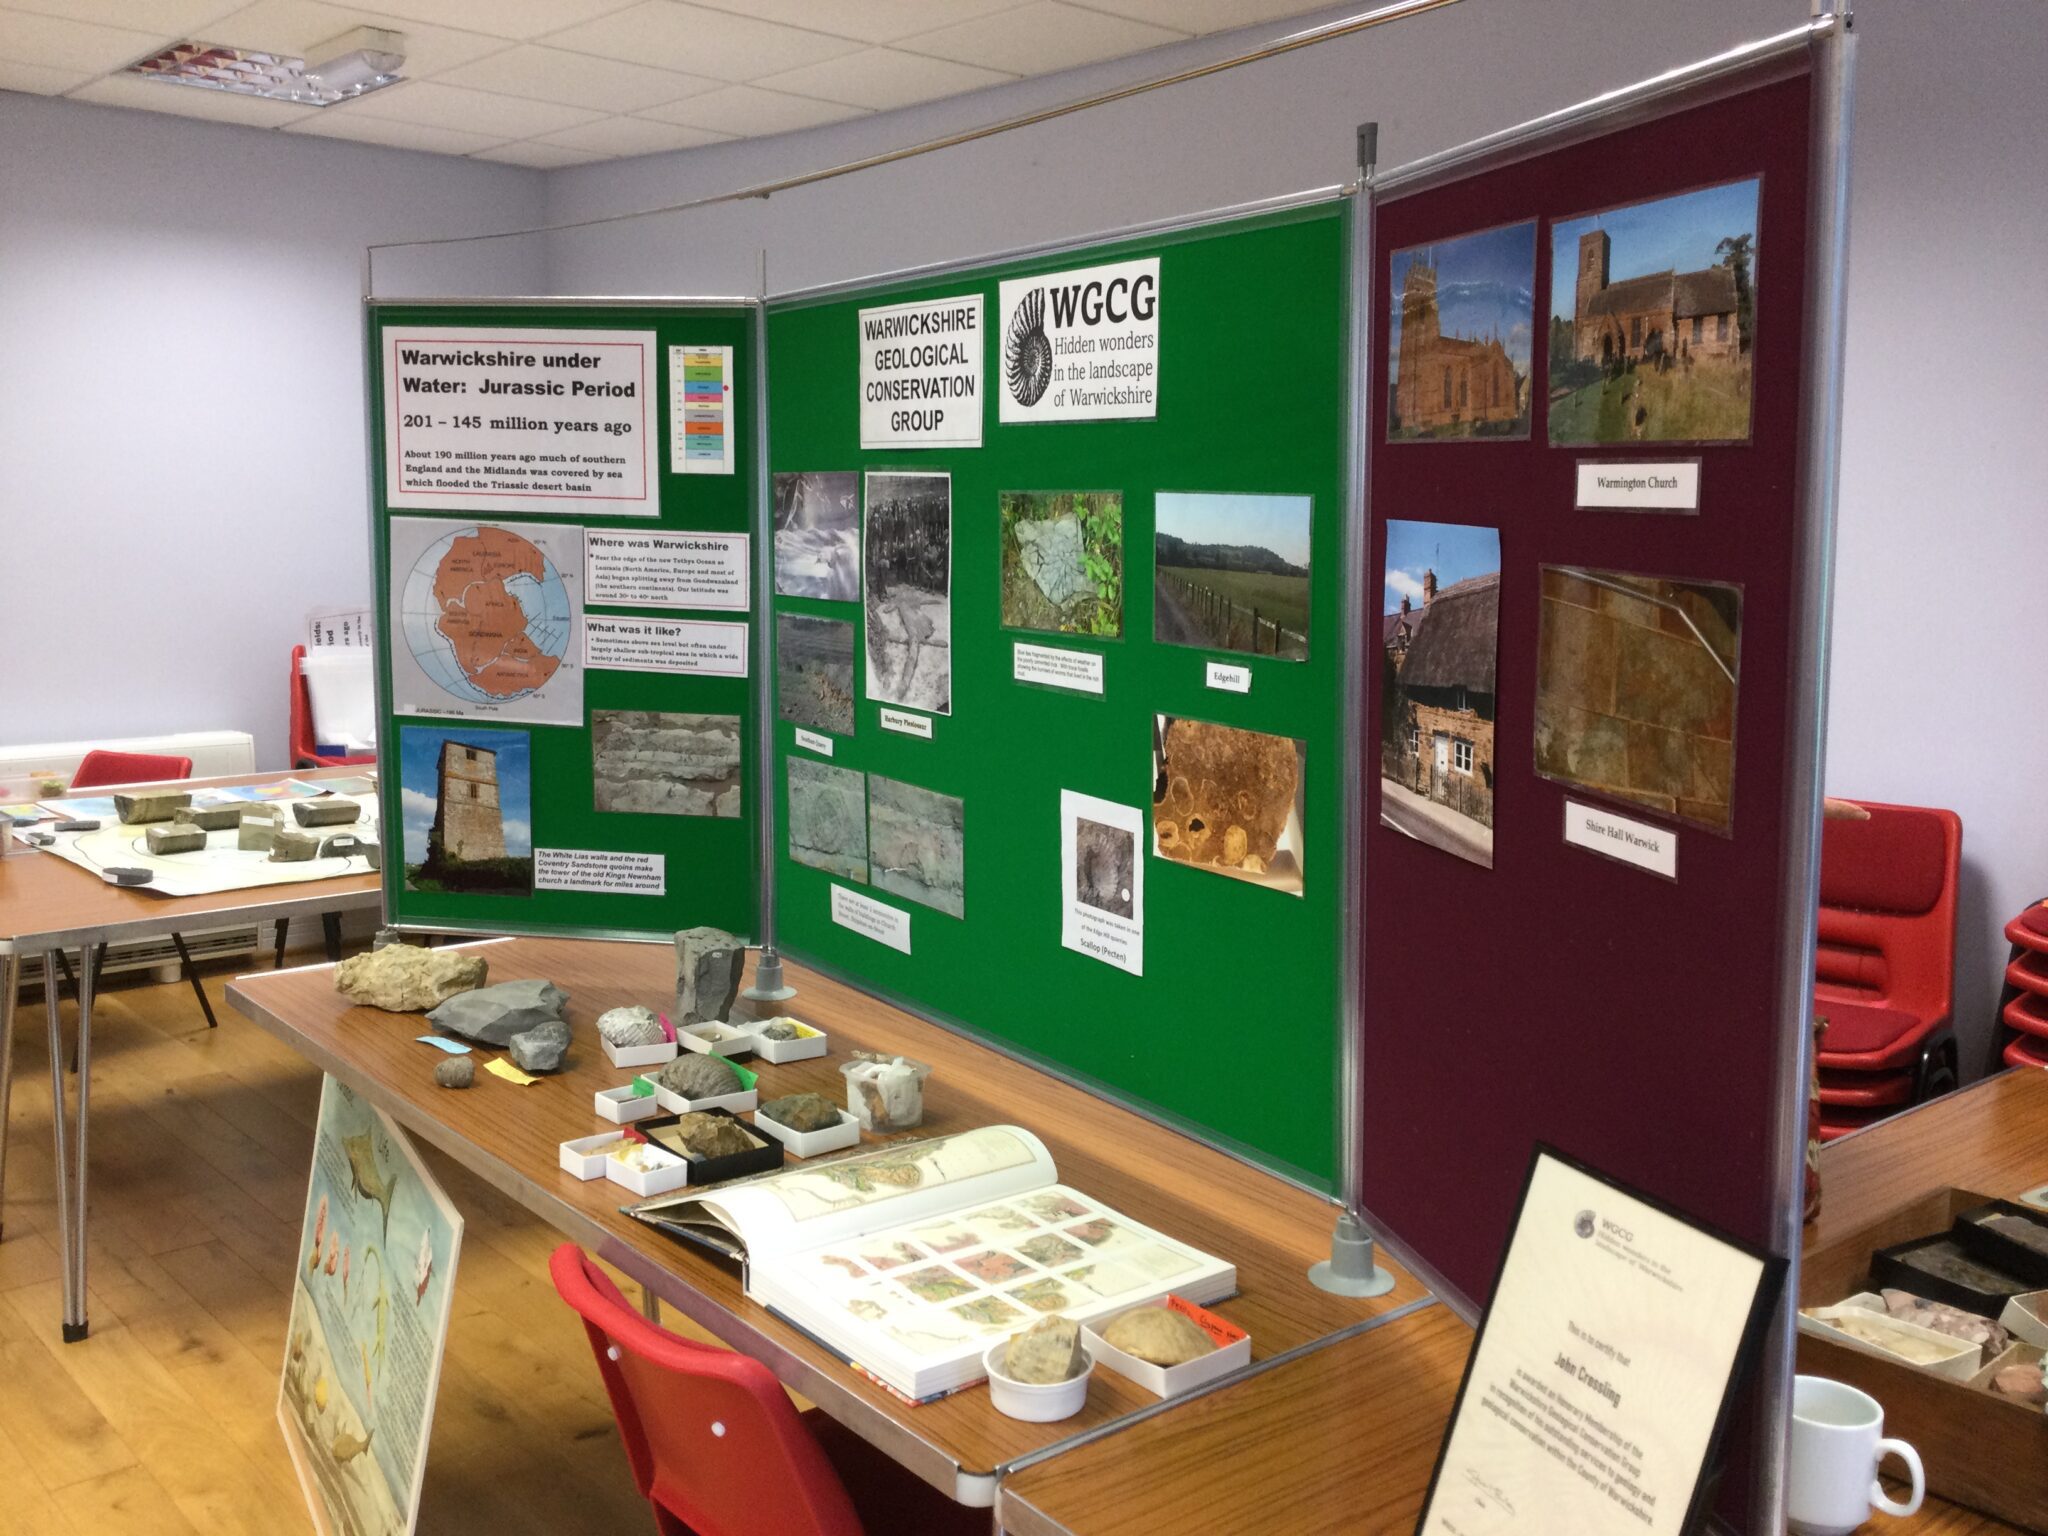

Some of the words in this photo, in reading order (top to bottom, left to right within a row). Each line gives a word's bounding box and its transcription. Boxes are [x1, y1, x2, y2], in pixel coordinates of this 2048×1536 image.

[1050, 274, 1156, 329] WGCG
[864, 307, 976, 341] WARWICKSHIRE
[1054, 334, 1096, 356] Hidden
[1099, 334, 1154, 352] wonders
[401, 350, 536, 367] Warwickshire
[542, 353, 601, 369] under
[874, 342, 968, 371] GEOLOGICAL
[1054, 363, 1064, 382] in
[1068, 362, 1086, 381] the
[1089, 358, 1153, 380] landscape
[403, 377, 466, 394] Water:
[479, 379, 565, 396] Jurassic
[571, 380, 635, 398] Period
[866, 375, 975, 402] CONSERVATION
[1053, 389, 1066, 408] of
[1070, 385, 1152, 407] Warwickshire
[403, 414, 432, 428] 201
[453, 415, 482, 429] 145
[489, 416, 548, 431] million
[553, 421, 599, 435] years
[604, 422, 632, 437] ago
[891, 409, 944, 432] GROUP
[404, 450, 432, 459] About
[435, 450, 452, 459] 190
[454, 451, 488, 460] million
[490, 454, 517, 462] years
[519, 454, 536, 464] ago
[539, 454, 567, 463] much
[569, 454, 581, 463] of
[582, 455, 626, 464] southern
[405, 464, 443, 475] England
[445, 465, 463, 474] and
[465, 466, 481, 474] the
[483, 466, 527, 476] Midlands
[550, 469, 590, 478] covered
[592, 469, 604, 480] by
[606, 471, 623, 479] sea
[405, 478, 433, 487] which
[436, 478, 470, 488] flooded
[472, 480, 488, 489] the
[490, 480, 529, 490] Triassic
[531, 482, 563, 491] desert
[565, 483, 592, 492] basin
[1597, 477, 1647, 491] Warmington
[1647, 476, 1678, 489] Church
[590, 537, 625, 547] Where
[627, 540, 650, 548] was
[652, 539, 729, 551] Warwickshire
[611, 574, 630, 582] began
[631, 575, 658, 583] splitting
[673, 567, 696, 575] Europe
[587, 622, 616, 633] What
[618, 626, 641, 634] was
[644, 625, 652, 635] it
[655, 626, 681, 637] like?
[591, 646, 612, 654] largely
[667, 659, 698, 667] deposited
[1214, 671, 1240, 686] Edgehill
[1586, 819, 1606, 836] Shire
[1607, 825, 1624, 842] Hall
[1624, 831, 1660, 854] Warwick
[538, 859, 570, 868] Coventry
[571, 861, 608, 870] Sandstone
[609, 864, 633, 872] quoins
[552, 851, 573, 859] White
[624, 855, 636, 863] the
[636, 856, 649, 864] red
[569, 878, 602, 886] landmark
[634, 882, 660, 890] around
[580, 870, 592, 878] the
[605, 871, 626, 880] Kings
[627, 873, 662, 881] Newnham
[1080, 937, 1101, 954] Scallop
[1101, 945, 1127, 964] (Pecten)
[1601, 1217, 1634, 1243] WGCG
[1554, 1352, 1577, 1377] John
